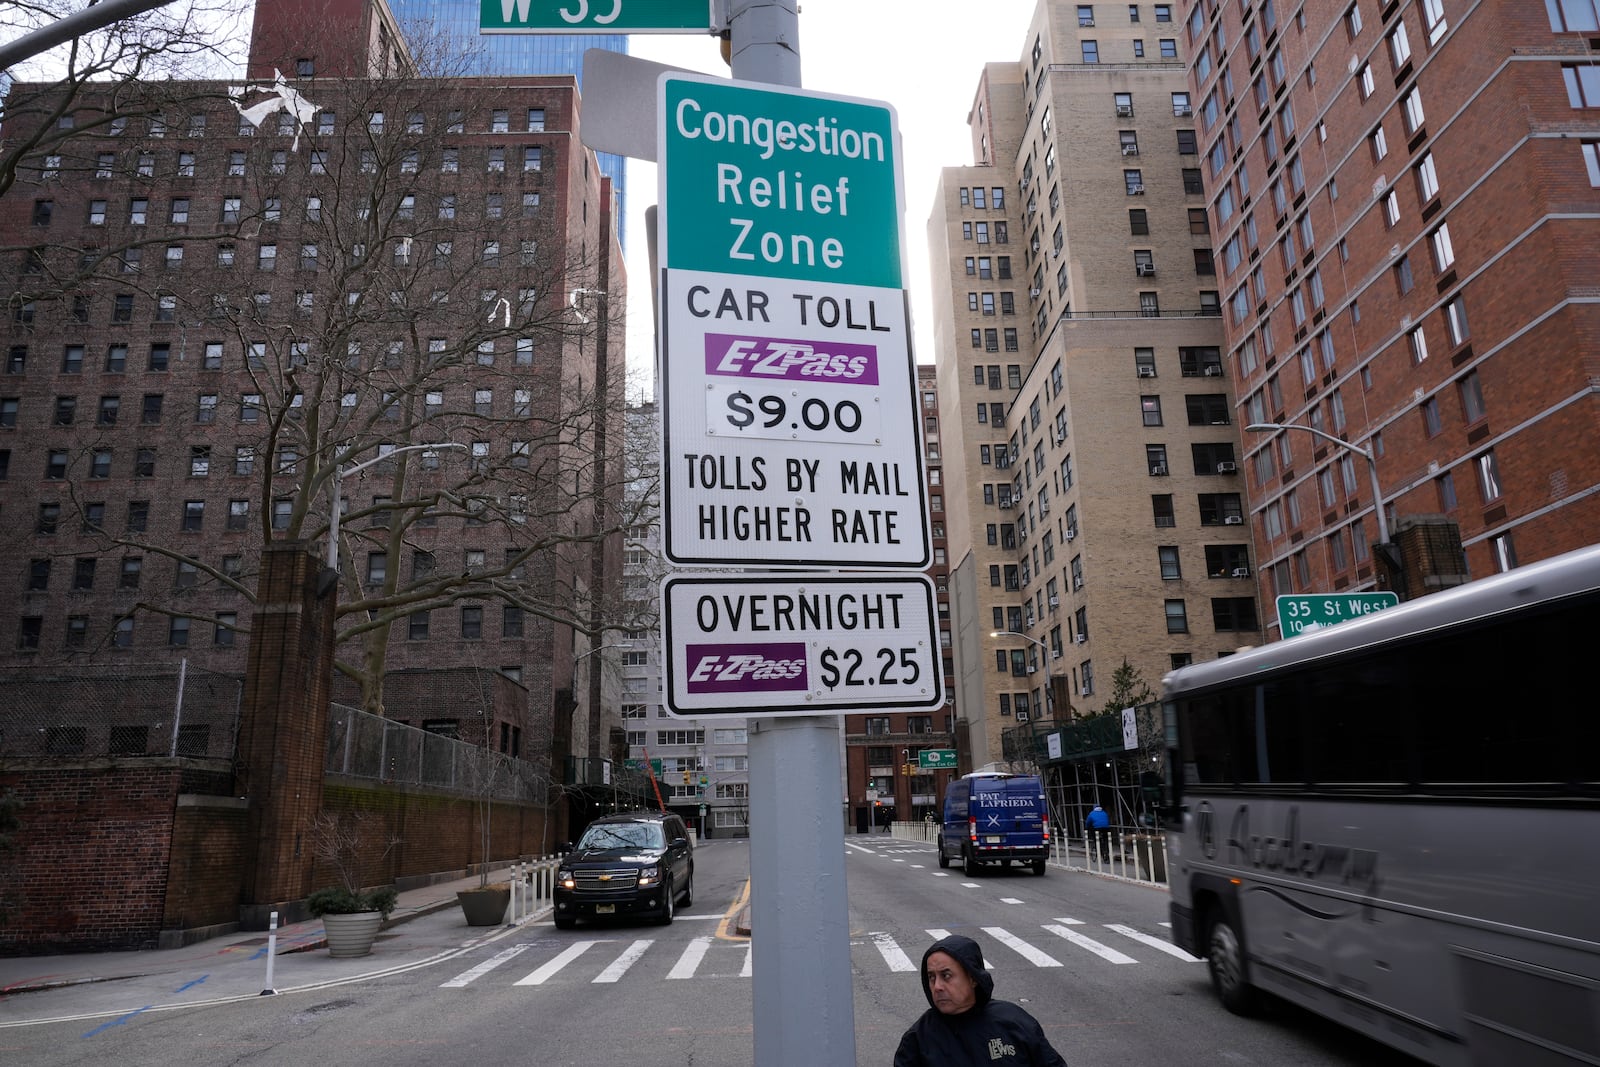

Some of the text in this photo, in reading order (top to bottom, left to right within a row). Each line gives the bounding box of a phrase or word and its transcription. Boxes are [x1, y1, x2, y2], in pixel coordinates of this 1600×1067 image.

[675, 98, 885, 162] Congestion
[717, 162, 850, 216] Relief
[729, 217, 844, 269] Zone
[687, 285, 891, 332] CAR TOLL
[716, 340, 868, 379] E-ZPass
[726, 390, 863, 433] $9.00
[684, 453, 909, 496] TOLLS BY MAIL
[699, 504, 901, 545] HIGHER RATE
[696, 593, 904, 633] OVERNIGHT
[1287, 599, 1389, 617] 35 St West
[688, 646, 920, 692] E-ZPass $2.25
[980, 792, 1000, 801] PAT
[980, 800, 1035, 808] LAFRIEDA
